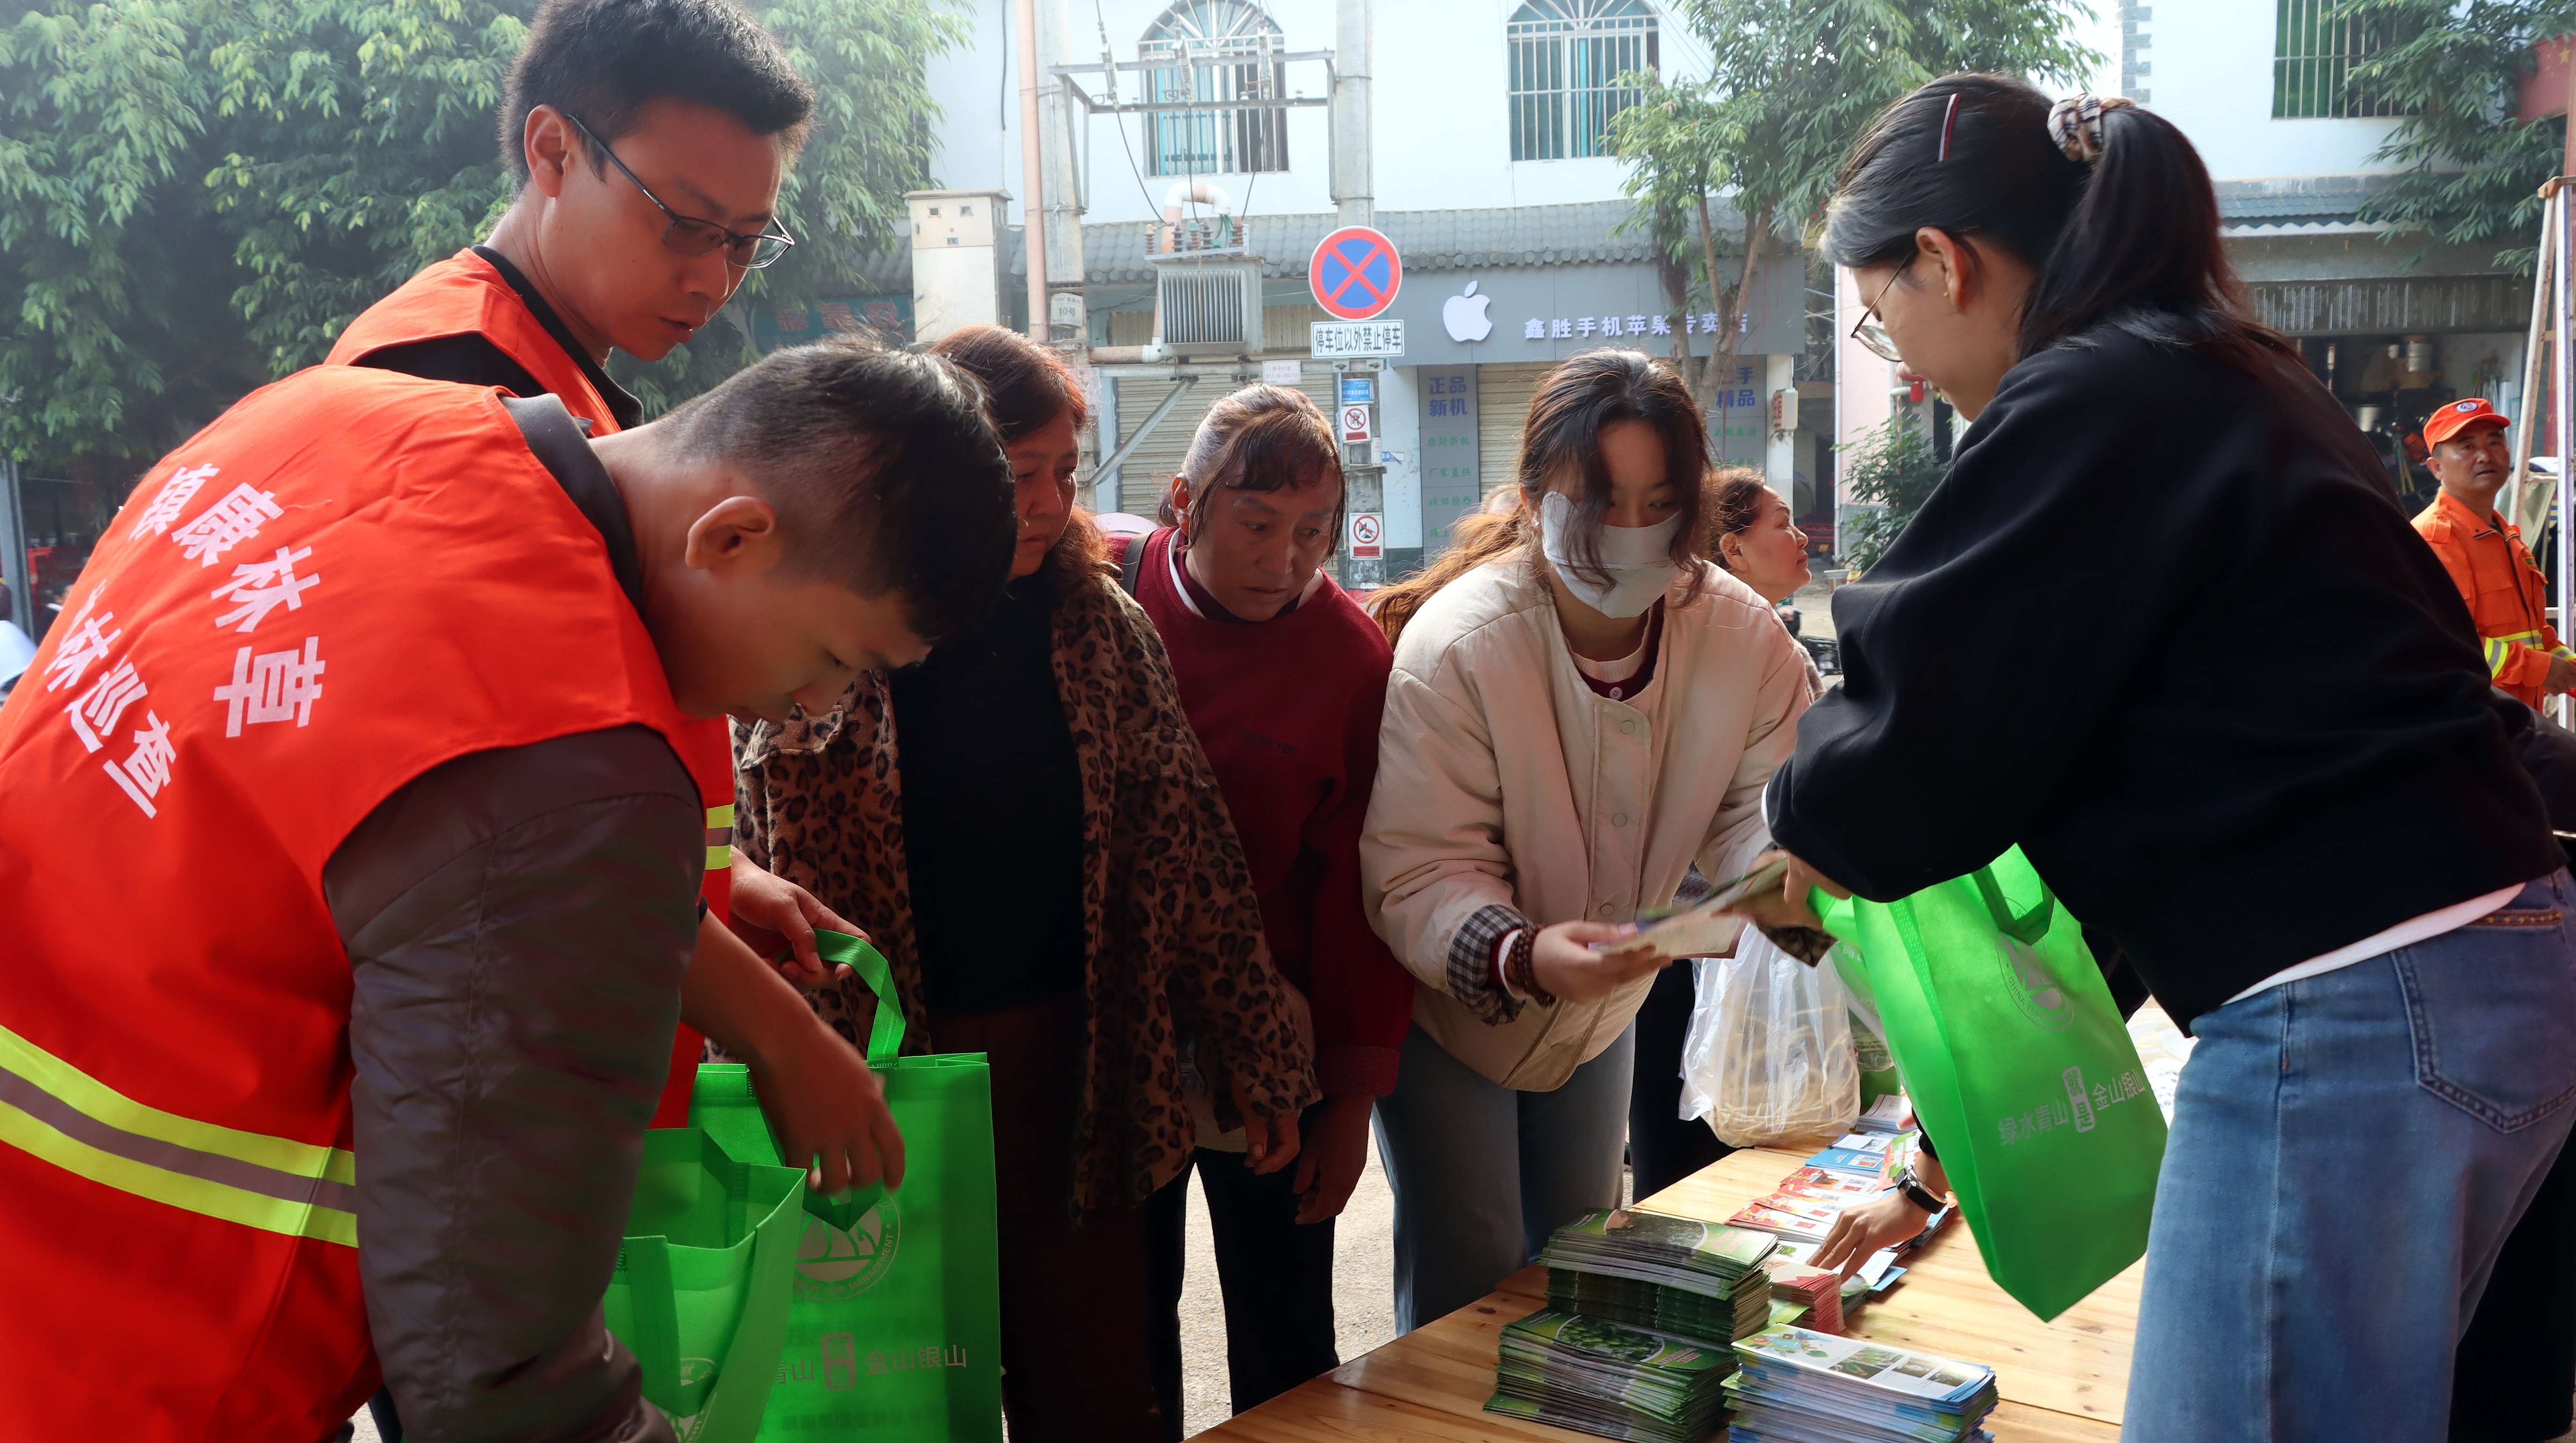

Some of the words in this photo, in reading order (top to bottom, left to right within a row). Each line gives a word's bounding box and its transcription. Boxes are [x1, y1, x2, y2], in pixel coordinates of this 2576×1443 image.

[1058, 307, 1076, 317] 10号
[1315, 325, 1401, 353] 停车位以外禁止停车
[1429, 376, 1467, 395] 正品
[1429, 398, 1468, 417] 新机
[1716, 389, 1755, 408] 精品
[2009, 976, 2026, 1006] CHINA
[1998, 1099, 2069, 1146] 绿水青山
[2092, 1068, 2146, 1111] 金山银山
[826, 1335, 853, 1388] 就是
[865, 1344, 967, 1375] 金山银山
